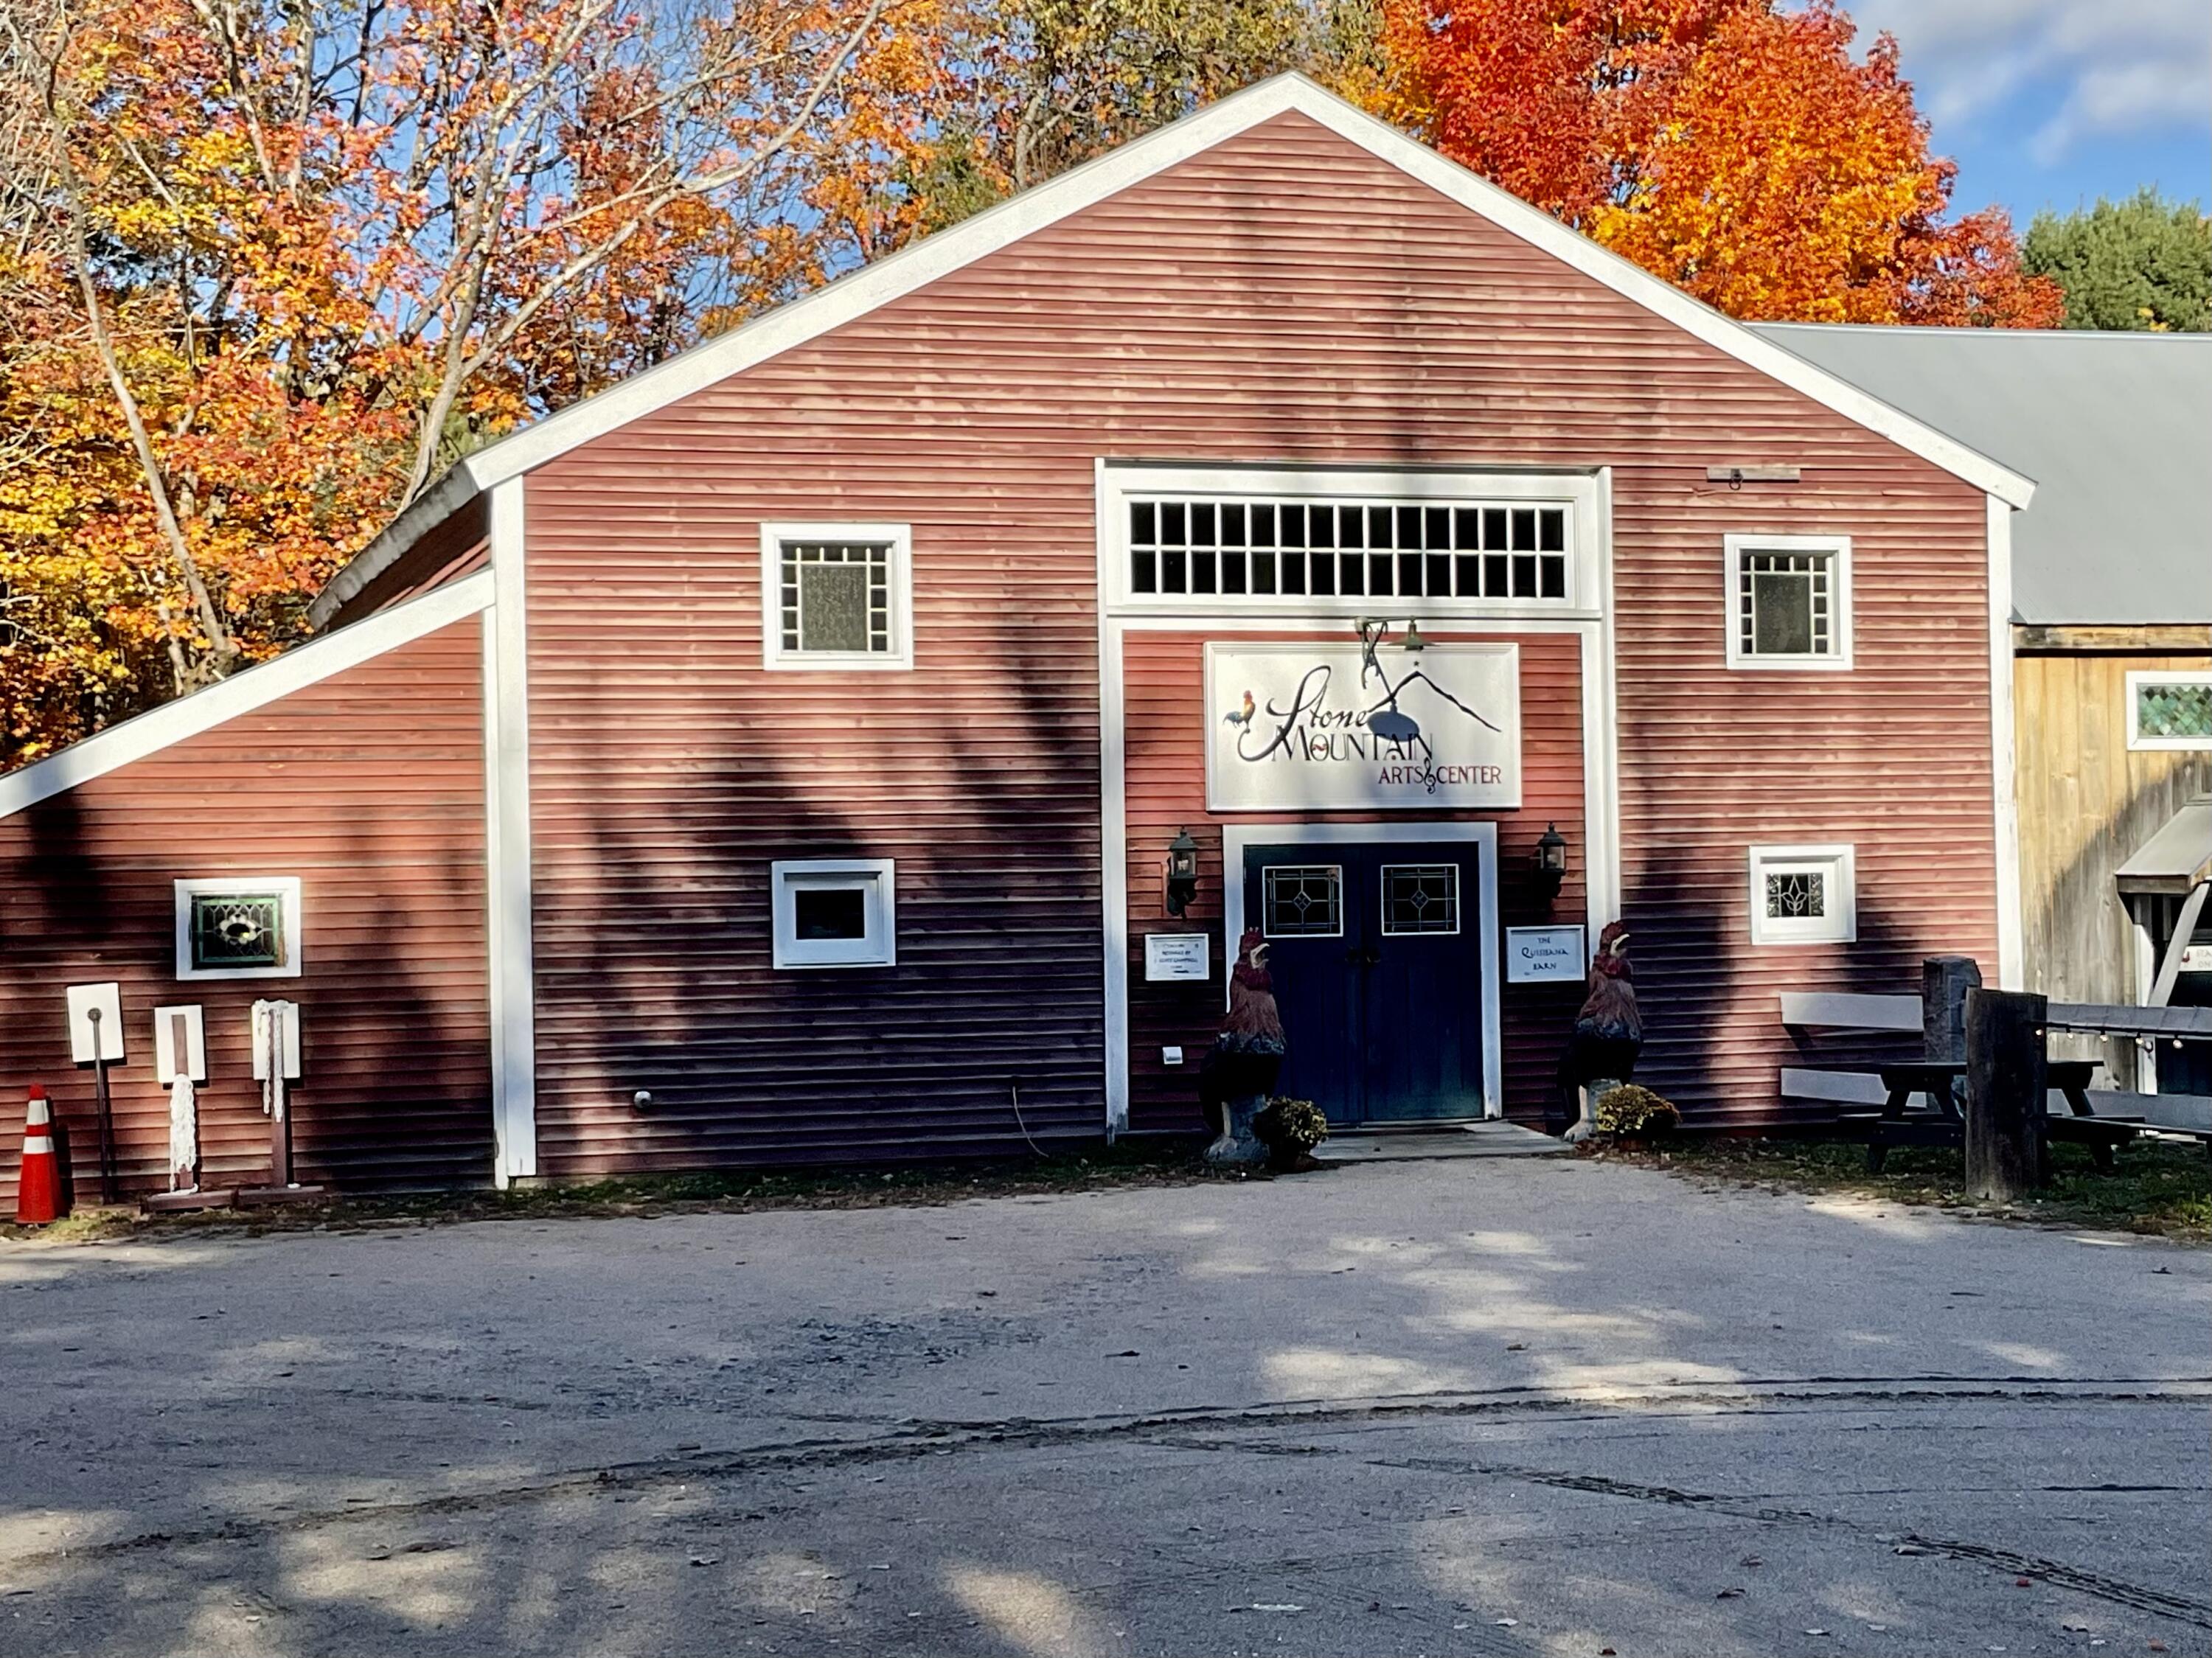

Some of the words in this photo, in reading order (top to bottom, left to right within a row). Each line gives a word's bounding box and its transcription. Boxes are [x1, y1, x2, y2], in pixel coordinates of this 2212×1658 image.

[1238, 665, 1371, 762] Stone
[1378, 766, 1424, 784] ARTS
[1437, 766, 1501, 784] CENTER
